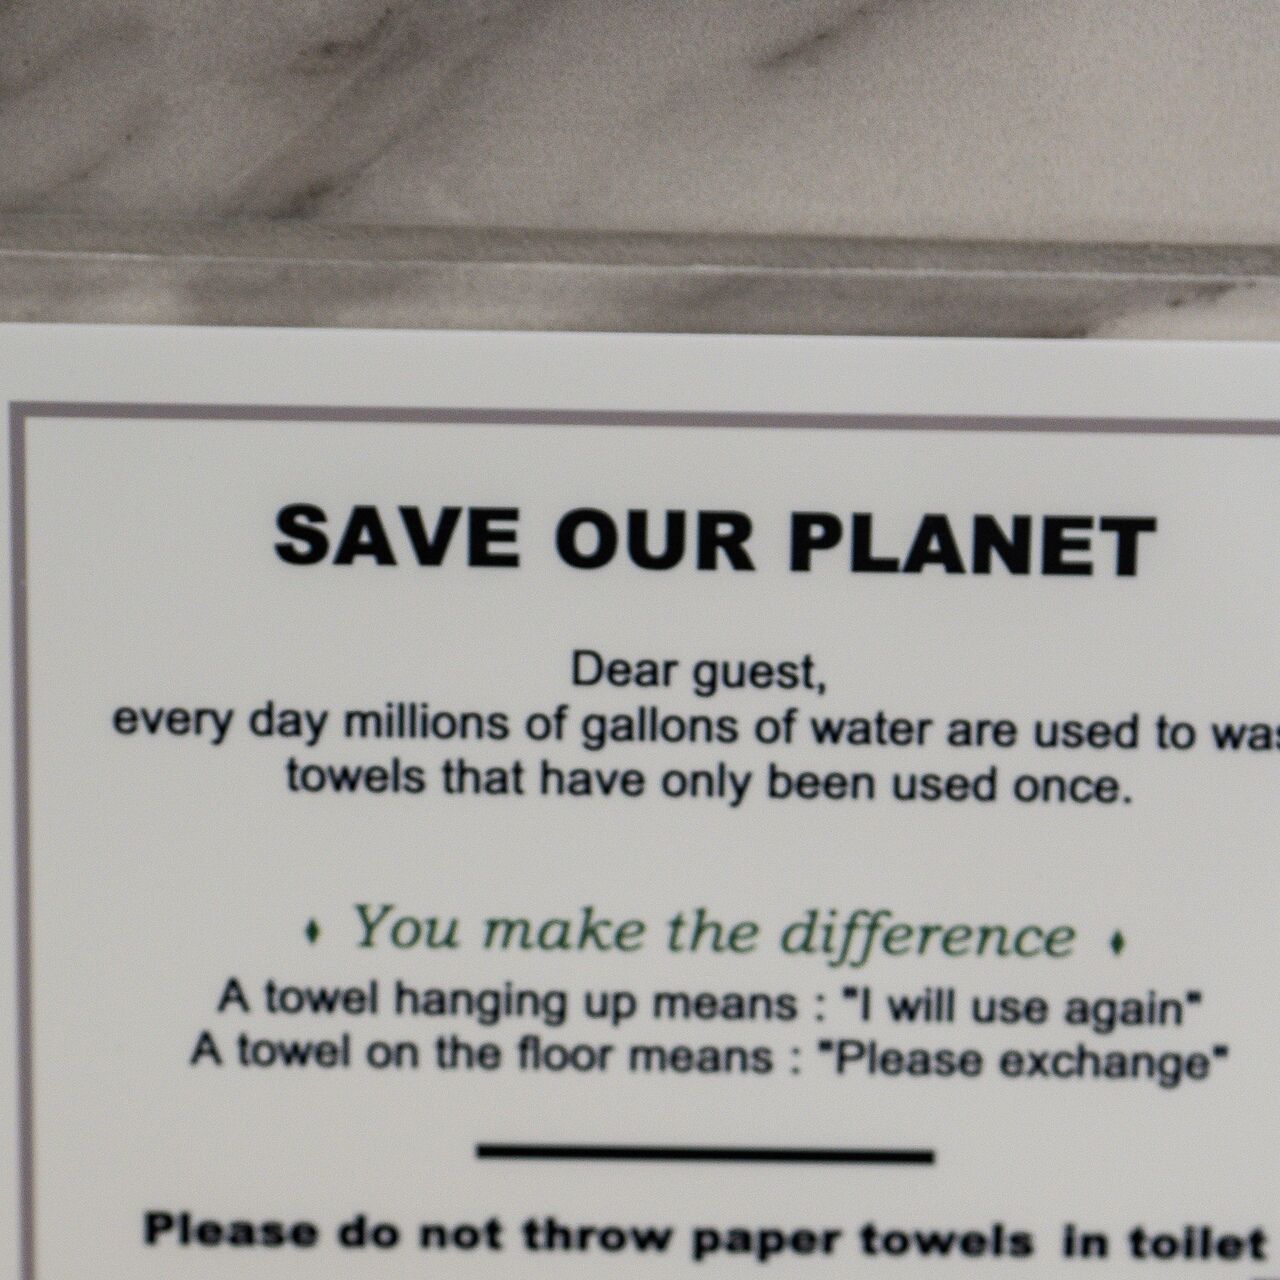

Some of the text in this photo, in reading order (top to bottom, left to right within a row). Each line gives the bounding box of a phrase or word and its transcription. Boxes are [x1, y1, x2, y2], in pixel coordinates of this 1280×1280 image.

[275, 503, 1157, 577] SAVE OUR PLANET
[572, 649, 826, 698] Dear guest,
[112, 707, 234, 746] every
[249, 700, 329, 747] day
[344, 702, 510, 741] millions
[525, 704, 569, 741] of
[581, 706, 739, 752] gallons
[754, 707, 798, 744] of
[811, 711, 933, 746] water
[947, 719, 1018, 748] are
[1034, 713, 1139, 750] used
[1156, 715, 1196, 750] to
[286, 757, 1131, 808] towels that have only been used once.
[355, 904, 1076, 969] You make the difference
[217, 977, 1202, 1035] A towel hanging up means : "I will use again"
[190, 1030, 1229, 1090] A towel on the floor means : "Please exchange"
[144, 1211, 1267, 1263] Please do not throw paper towels in toilet
